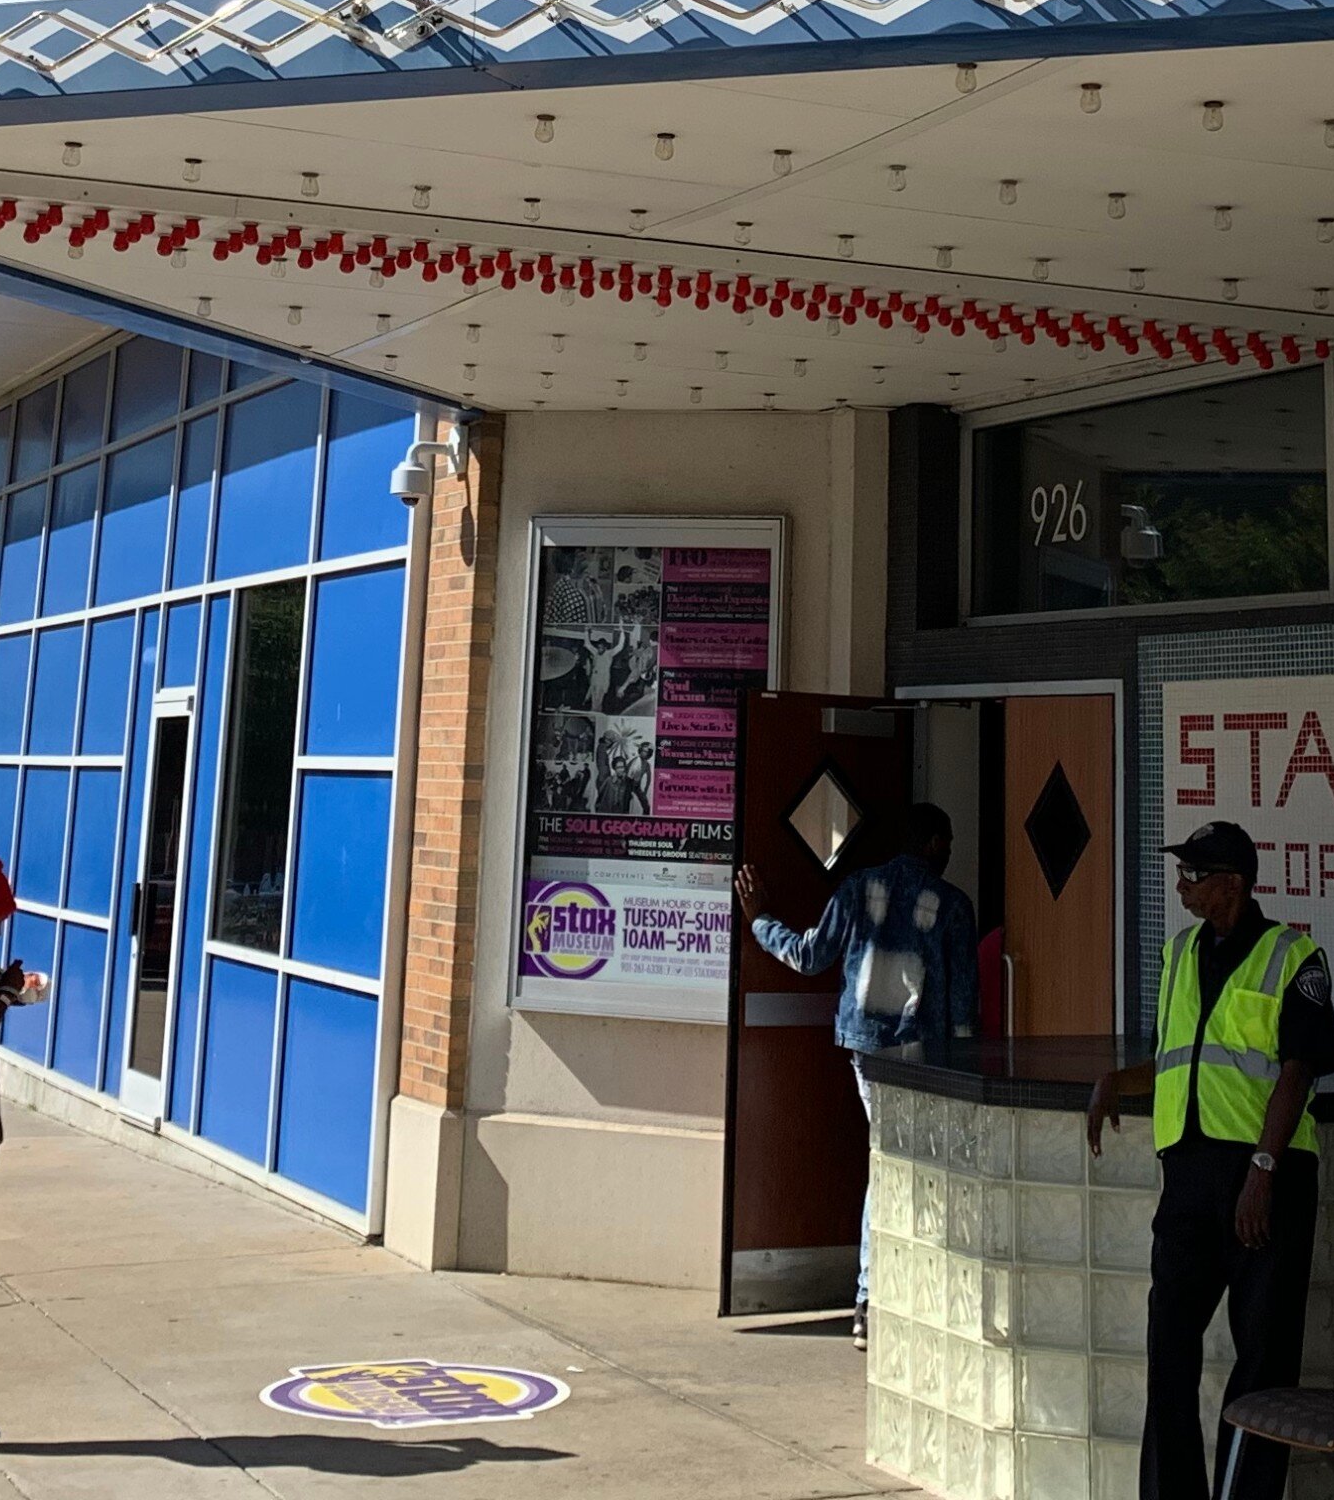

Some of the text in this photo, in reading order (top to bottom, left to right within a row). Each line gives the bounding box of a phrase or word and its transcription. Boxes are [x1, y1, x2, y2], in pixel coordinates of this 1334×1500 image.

[1031, 480, 1086, 546] 926
[663, 679, 689, 691] Soul
[663, 691, 706, 702] Cinema
[662, 721, 680, 731] Live
[690, 721, 720, 731] Studio
[659, 781, 699, 792] Groove
[539, 817, 733, 841] THE SOUL GEOGRAPHY FILM S
[657, 841, 673, 849] SOUL
[623, 897, 731, 912] MUSEUM HOURS OF OPER
[553, 902, 616, 936] stax
[552, 932, 614, 951] MUSEUM
[715, 934, 731, 944] CLO
[715, 946, 731, 955] MO
